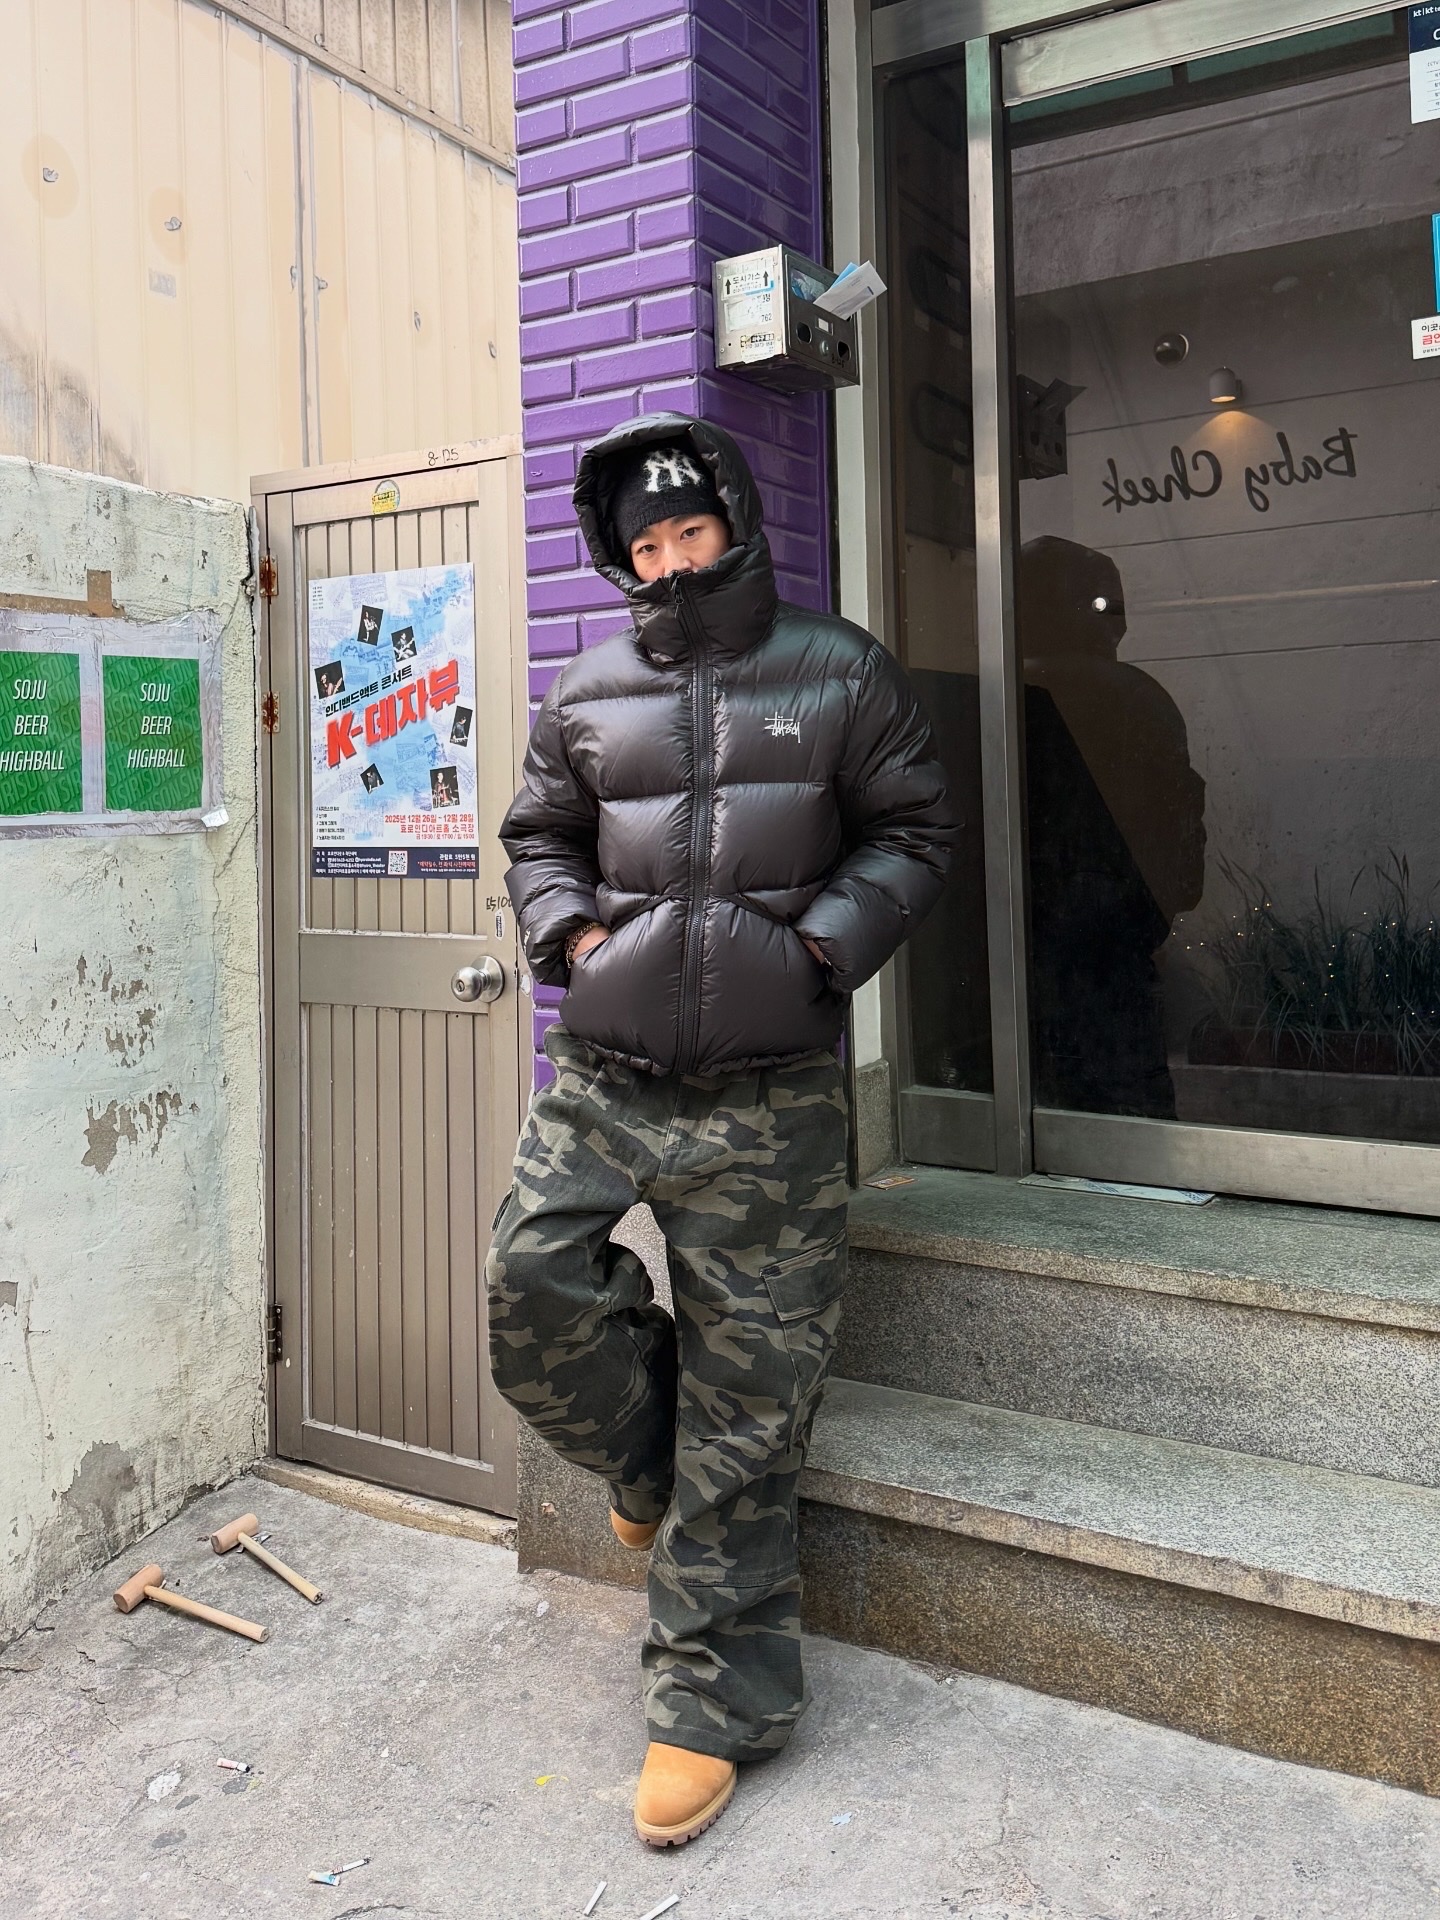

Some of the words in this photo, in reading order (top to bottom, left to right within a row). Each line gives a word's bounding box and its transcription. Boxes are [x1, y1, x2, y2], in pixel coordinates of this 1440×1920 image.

[732, 272, 761, 285] 도시가스
[1421, 323, 1440, 332] 이곳
[381, 664, 413, 690] 콘서트
[13, 678, 47, 700] SOJU
[140, 683, 171, 702] SOJU
[14, 714, 49, 736] BEER
[141, 716, 172, 735] BEER
[0, 750, 65, 772] HIGHBALL
[127, 748, 186, 768] HIGHBALL
[384, 814, 406, 824] 2025년
[407, 814, 421, 823] 12월
[422, 814, 437, 823] 26일
[443, 814, 458, 823] 12월
[459, 813, 474, 823] 28일
[452, 824, 474, 833] 소극장
